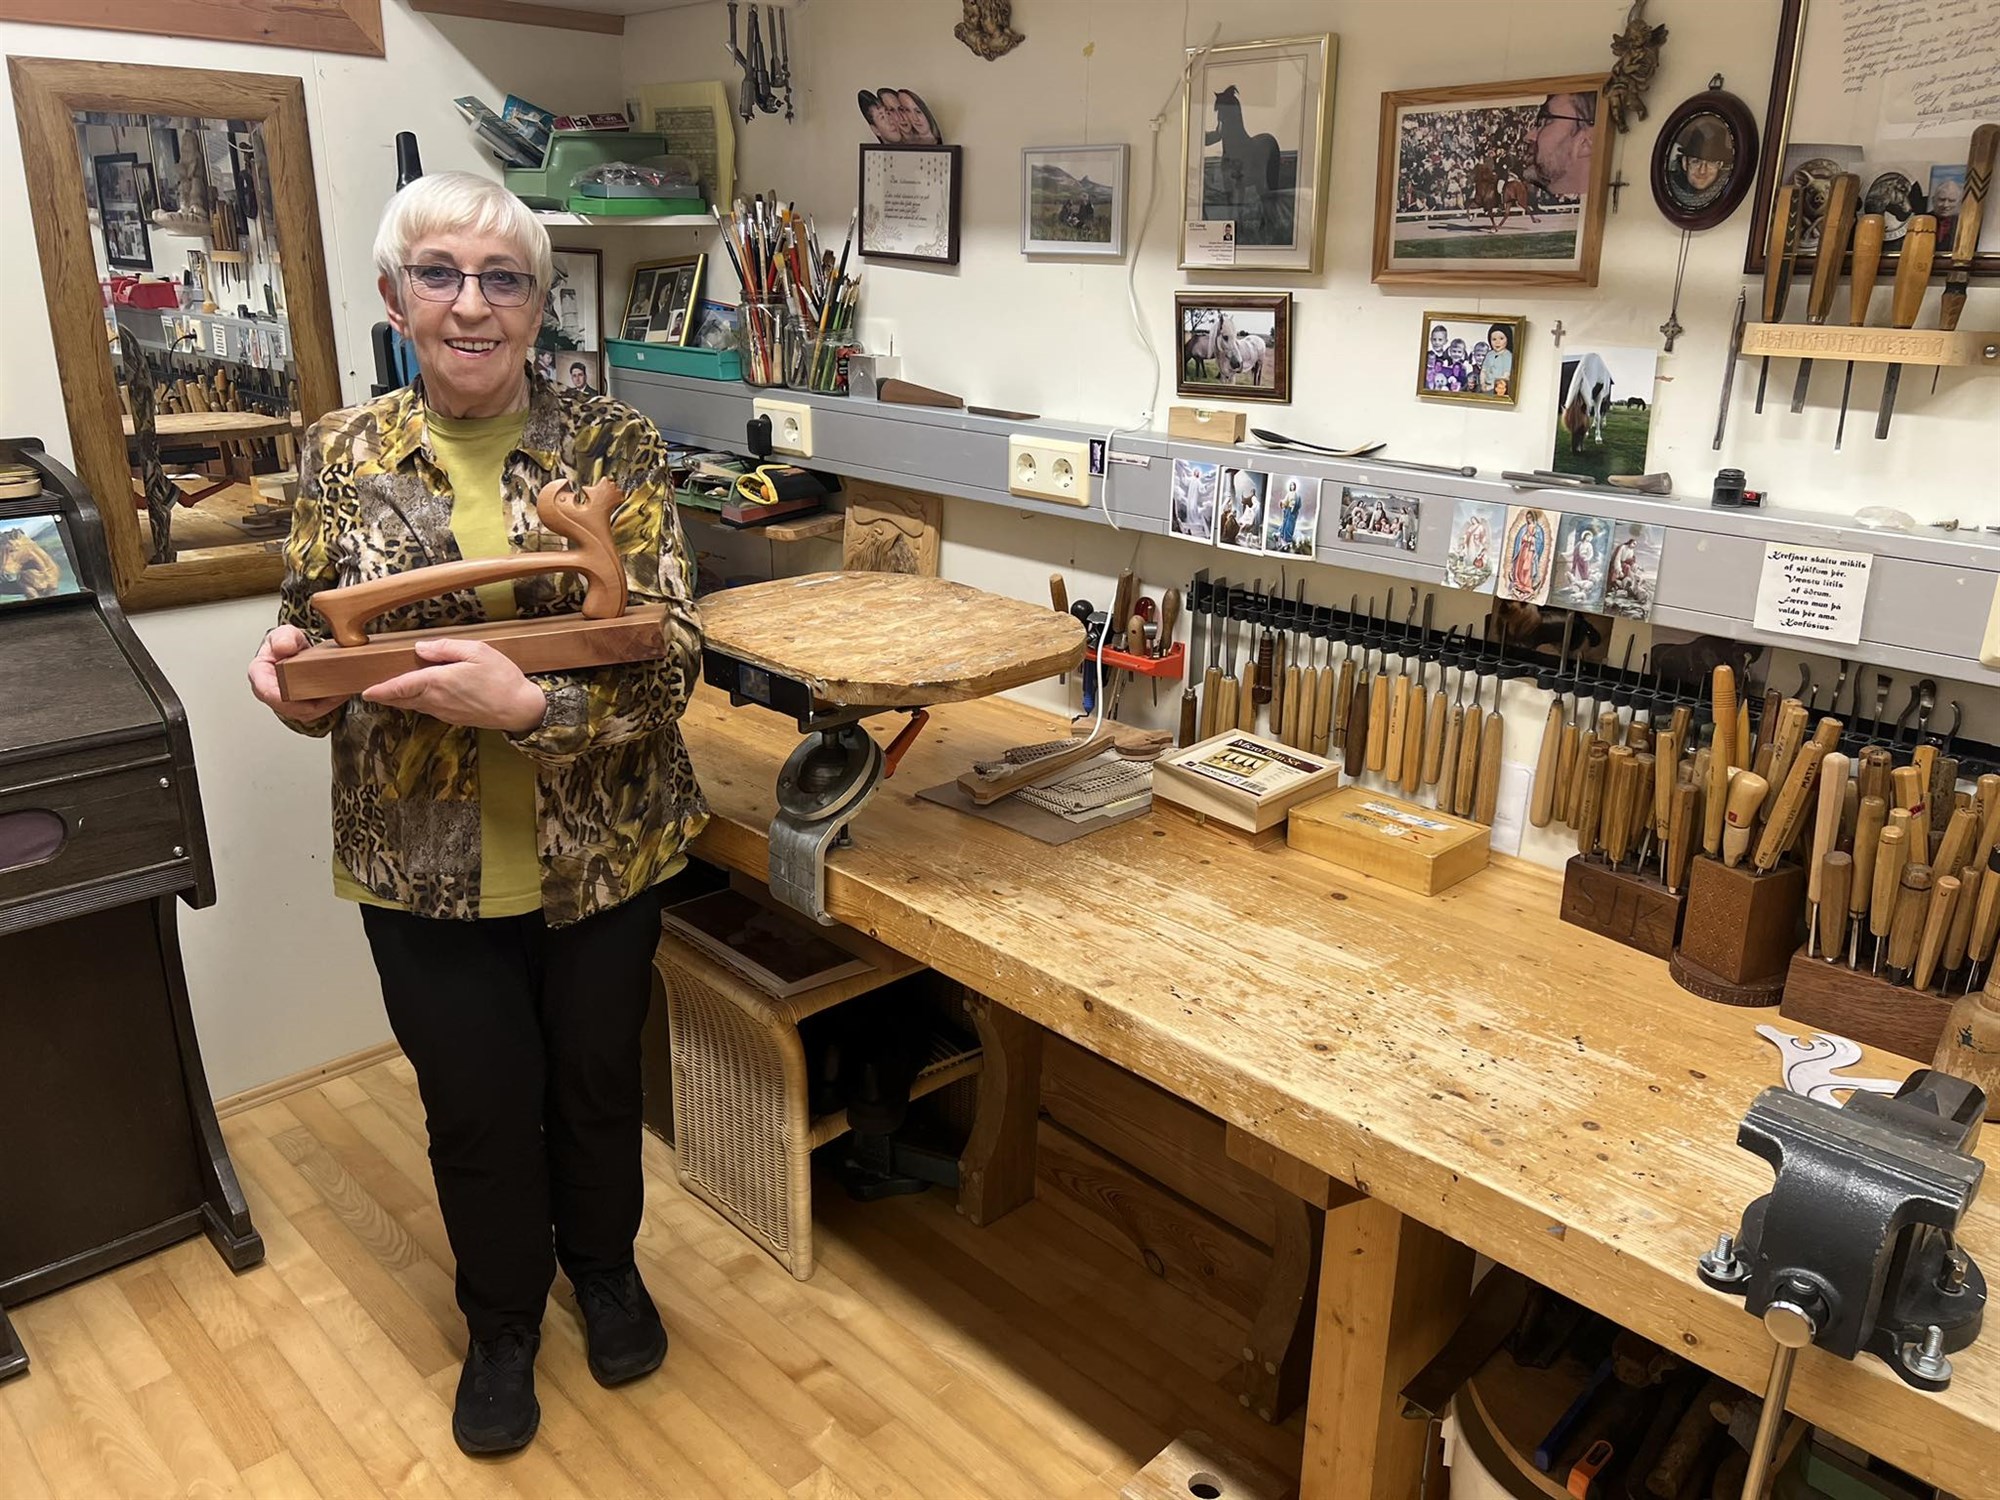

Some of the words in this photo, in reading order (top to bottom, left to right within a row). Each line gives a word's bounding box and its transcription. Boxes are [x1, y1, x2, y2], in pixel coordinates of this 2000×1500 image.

[1767, 551, 1808, 562] Krefjast
[1810, 555, 1837, 565] skaltu
[1840, 559, 1866, 569] mikils
[1778, 607, 1800, 615] valda
[1811, 600, 1828, 608] mun
[1234, 740, 1262, 753] Micro
[1286, 757, 1301, 766] Set
[1801, 762, 1817, 789] MATTA
[1571, 875, 1666, 947] SJK
